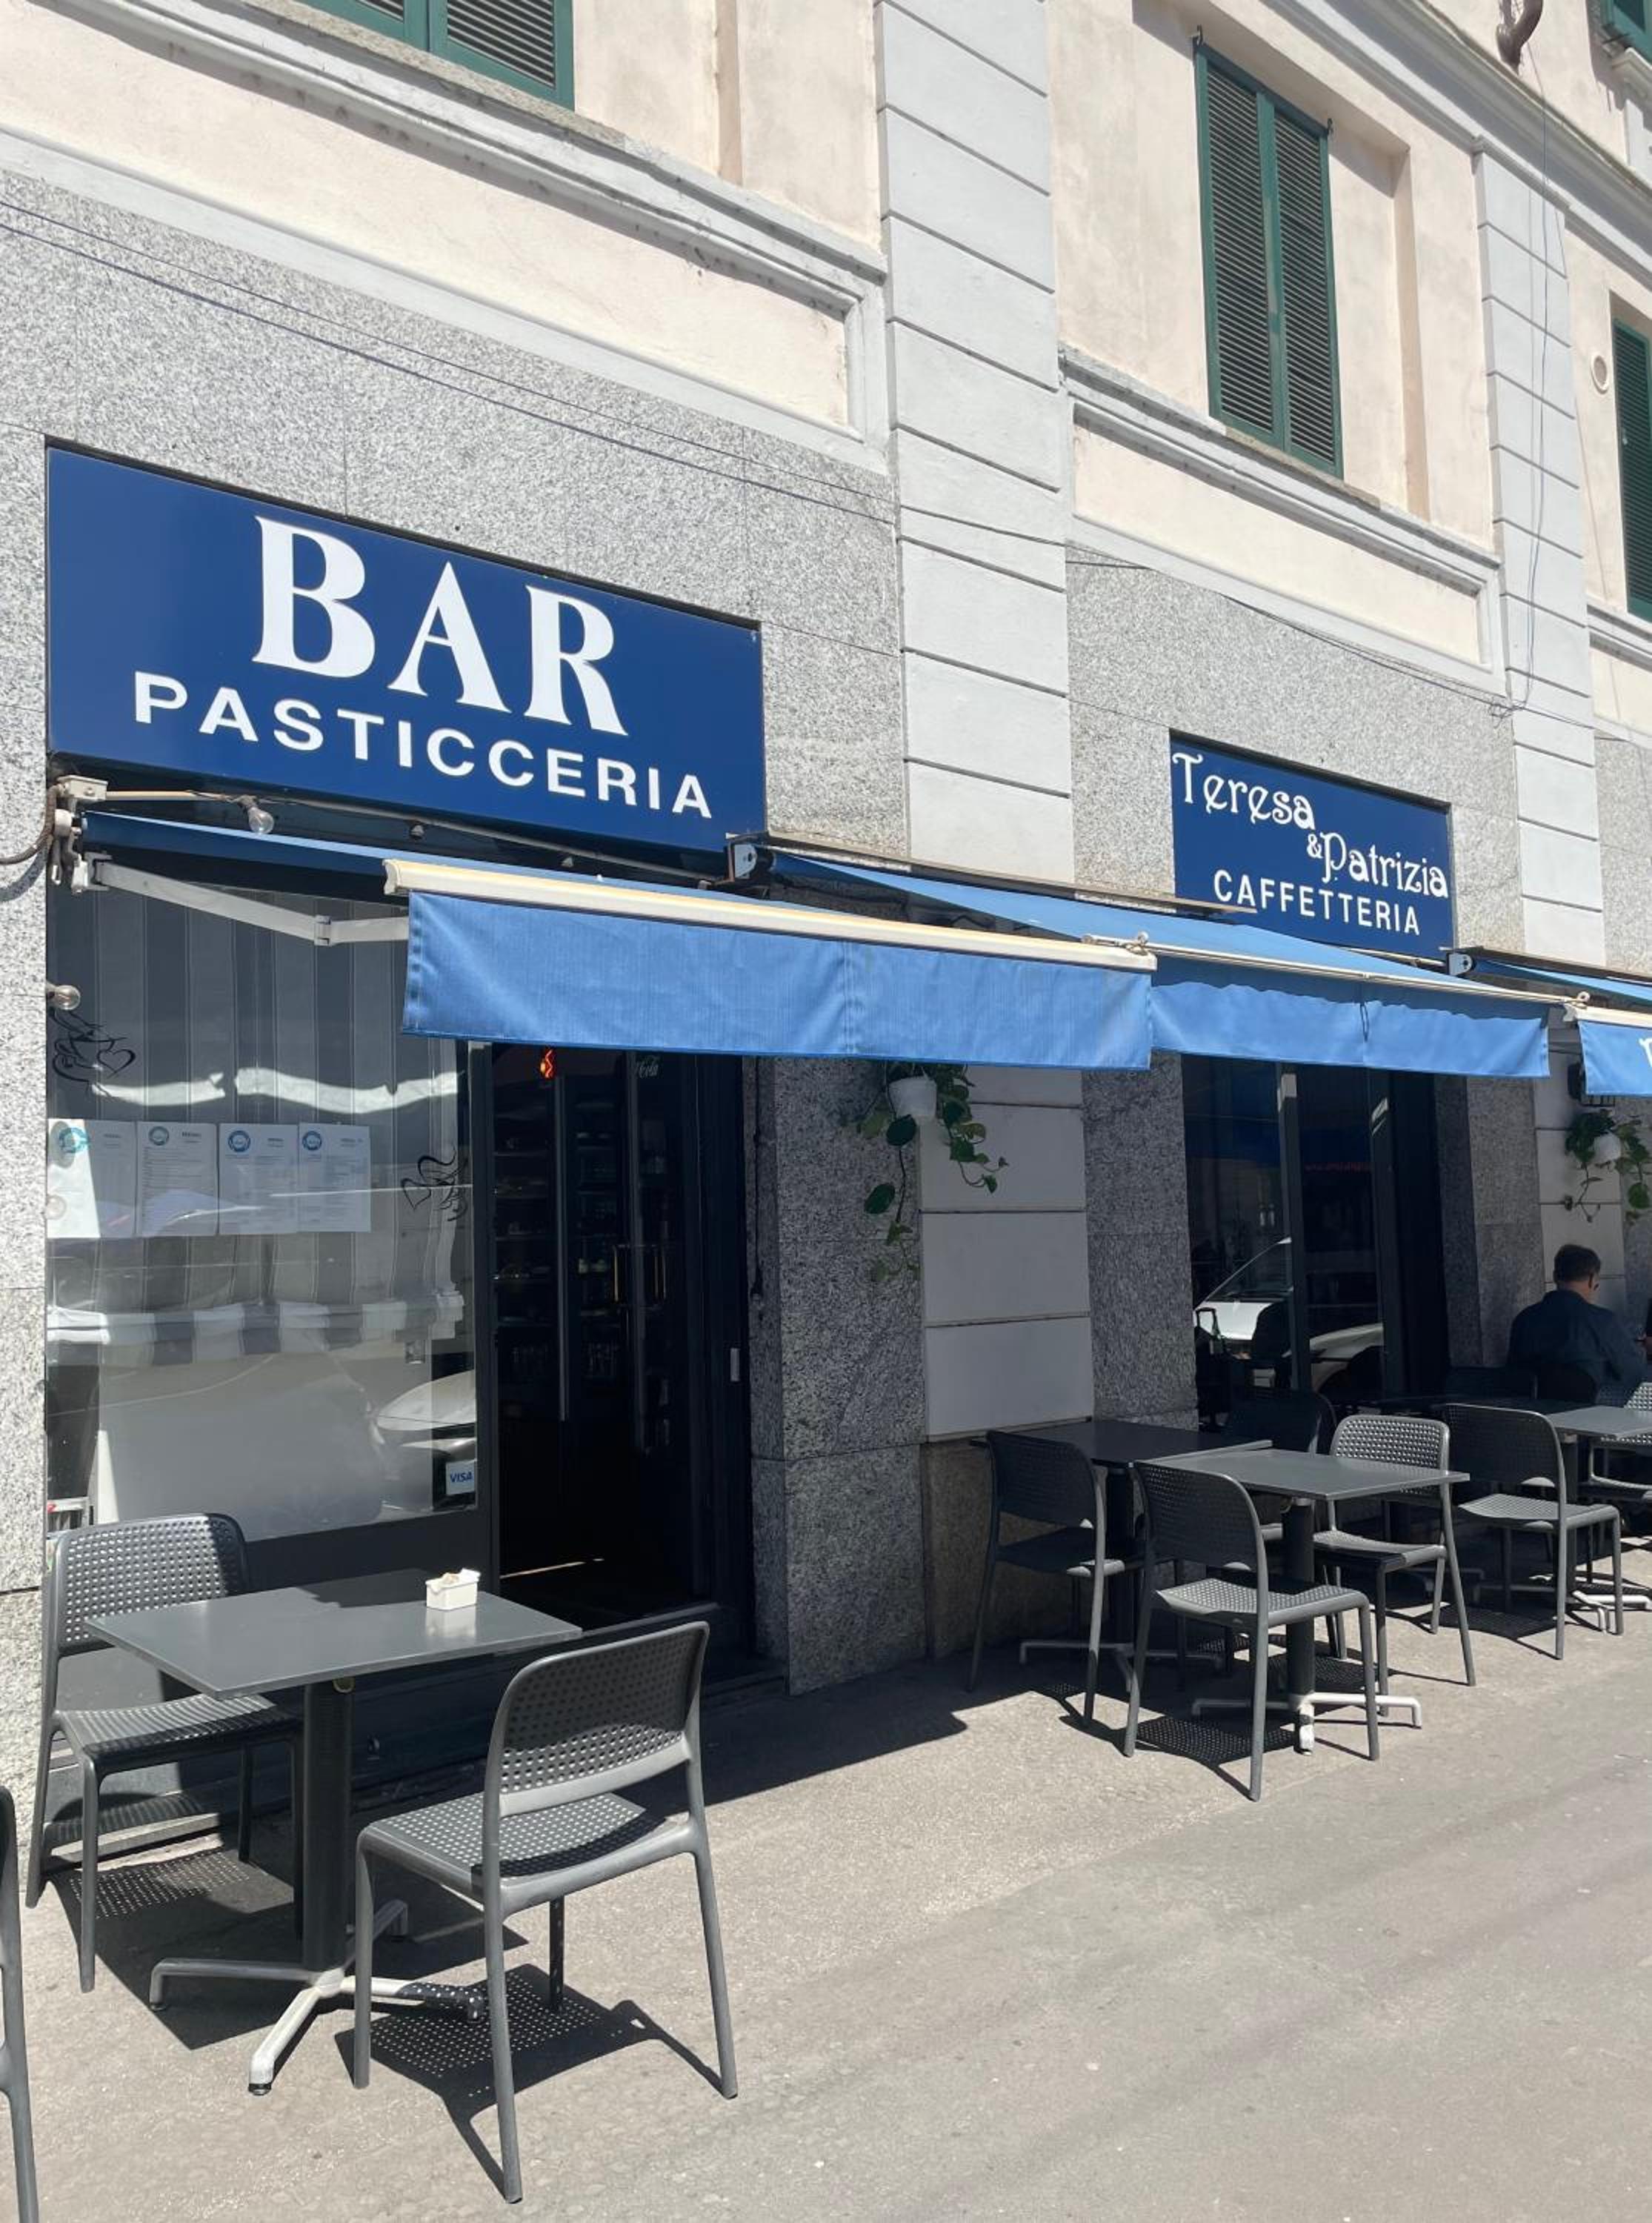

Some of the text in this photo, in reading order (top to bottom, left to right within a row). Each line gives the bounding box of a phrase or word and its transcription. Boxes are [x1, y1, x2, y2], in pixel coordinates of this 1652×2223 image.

[252, 516, 628, 736] BAR
[134, 671, 712, 819] PASTICCERIA
[1172, 752, 1316, 831] Teresa
[1213, 869, 1421, 937] CAFFETTERIA
[450, 1472, 473, 1483] VISA
